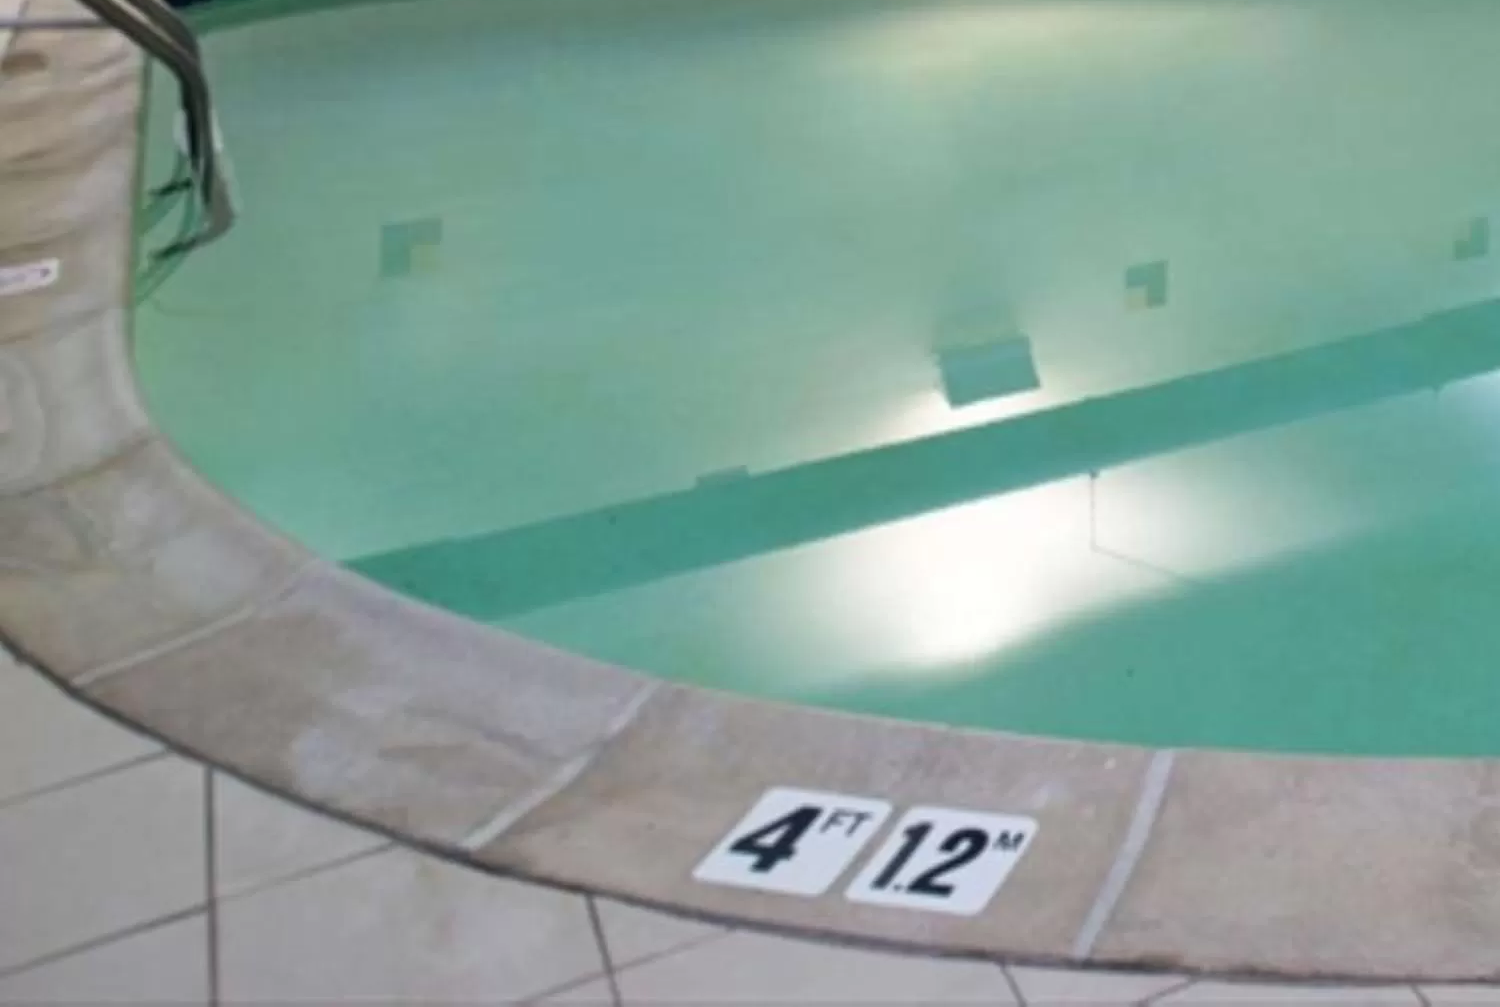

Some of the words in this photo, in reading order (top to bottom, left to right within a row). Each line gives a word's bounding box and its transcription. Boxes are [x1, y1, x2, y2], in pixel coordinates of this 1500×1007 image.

[727, 805, 822, 873] 4
[820, 808, 874, 838] FT
[992, 830, 1027, 854] M
